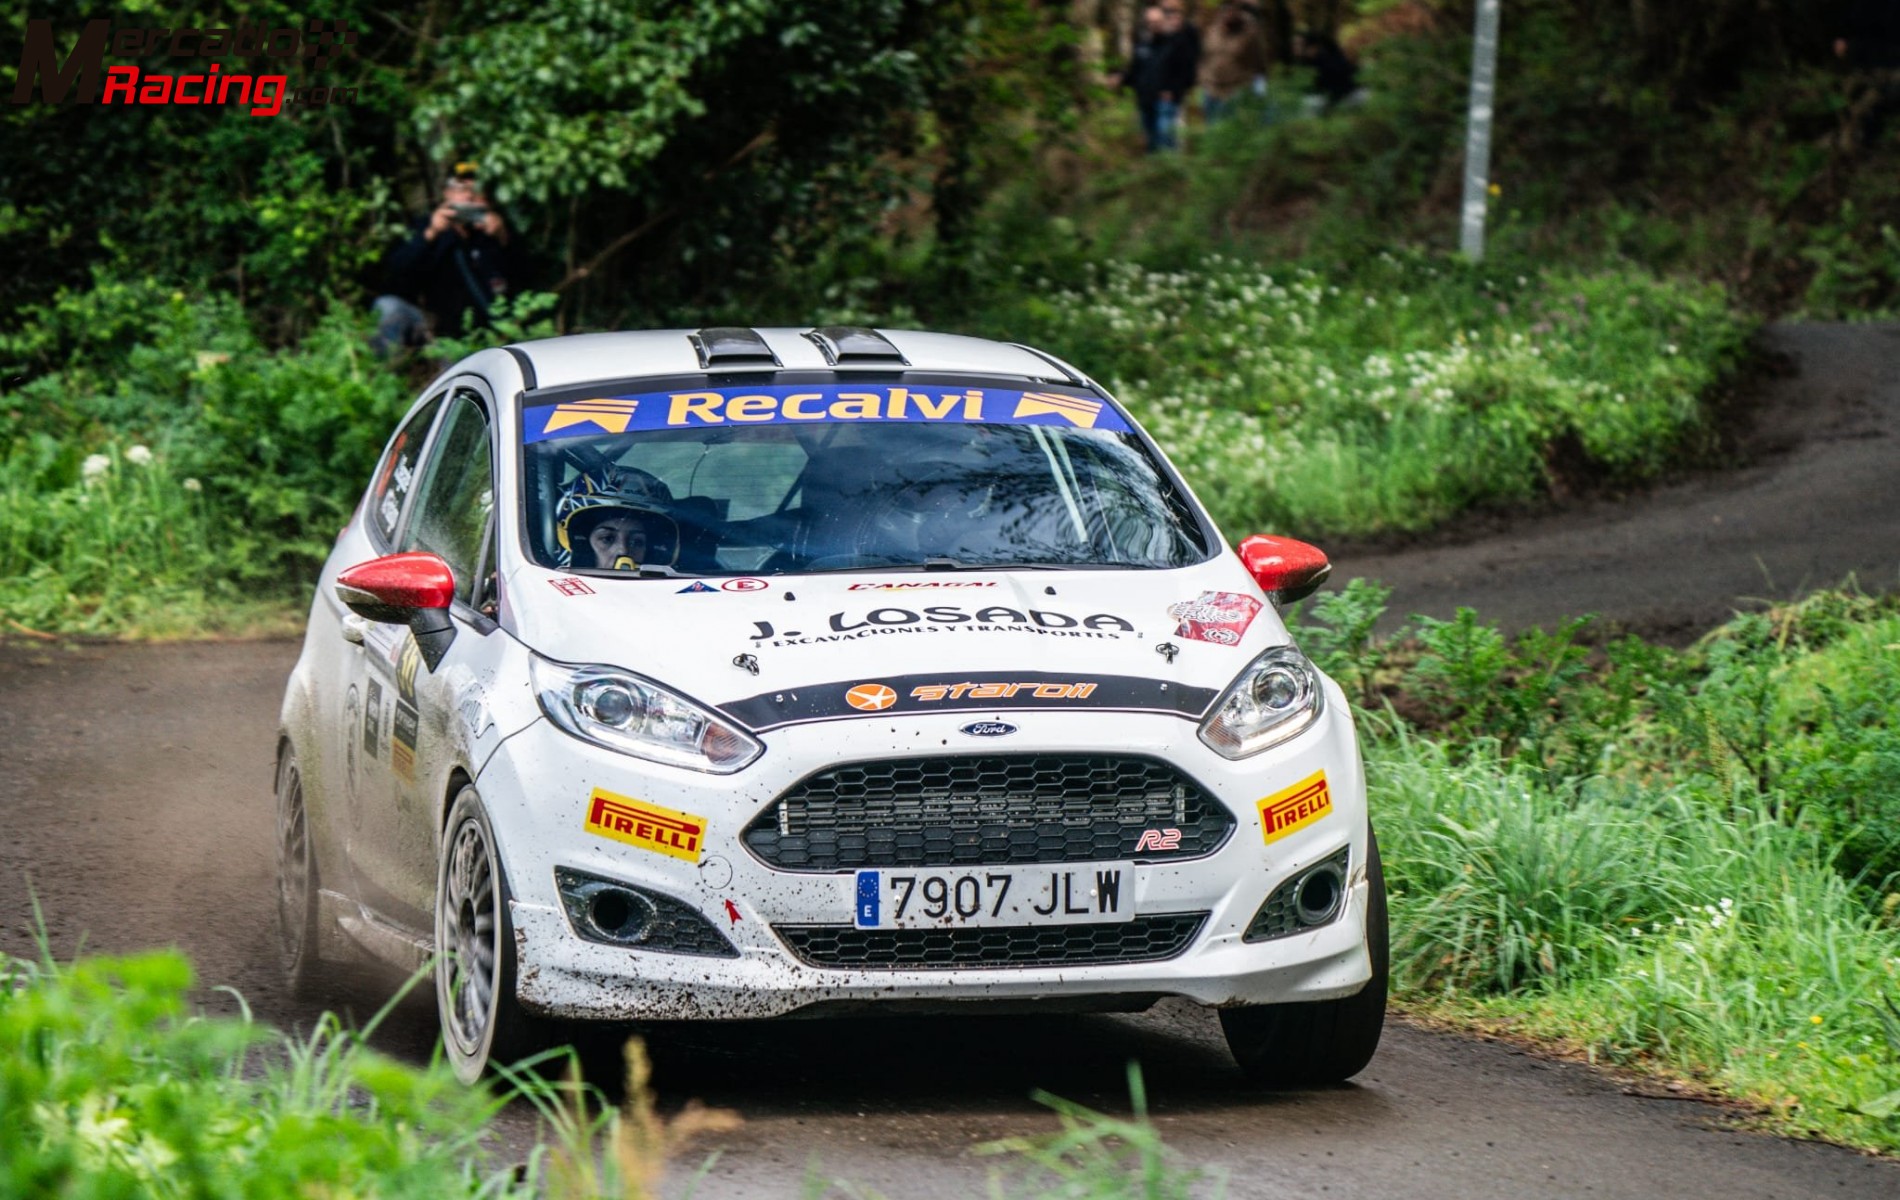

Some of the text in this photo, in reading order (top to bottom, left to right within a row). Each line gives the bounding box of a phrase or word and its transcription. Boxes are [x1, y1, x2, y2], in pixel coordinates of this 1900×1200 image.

[667, 388, 984, 425] Recalvi
[737, 581, 755, 590] E
[749, 606, 1135, 640] J. LOSADA
[773, 626, 939, 647] EXCAVACIONES
[964, 625, 1120, 640] TRANSPORTES
[910, 682, 1098, 701] staroil
[972, 722, 1006, 736] Ford
[1263, 779, 1330, 835] PIRELLI
[590, 797, 700, 852] PIRELLI
[1135, 829, 1182, 851] R2
[890, 870, 1121, 919] 7907 JLW
[864, 904, 872, 918] E
